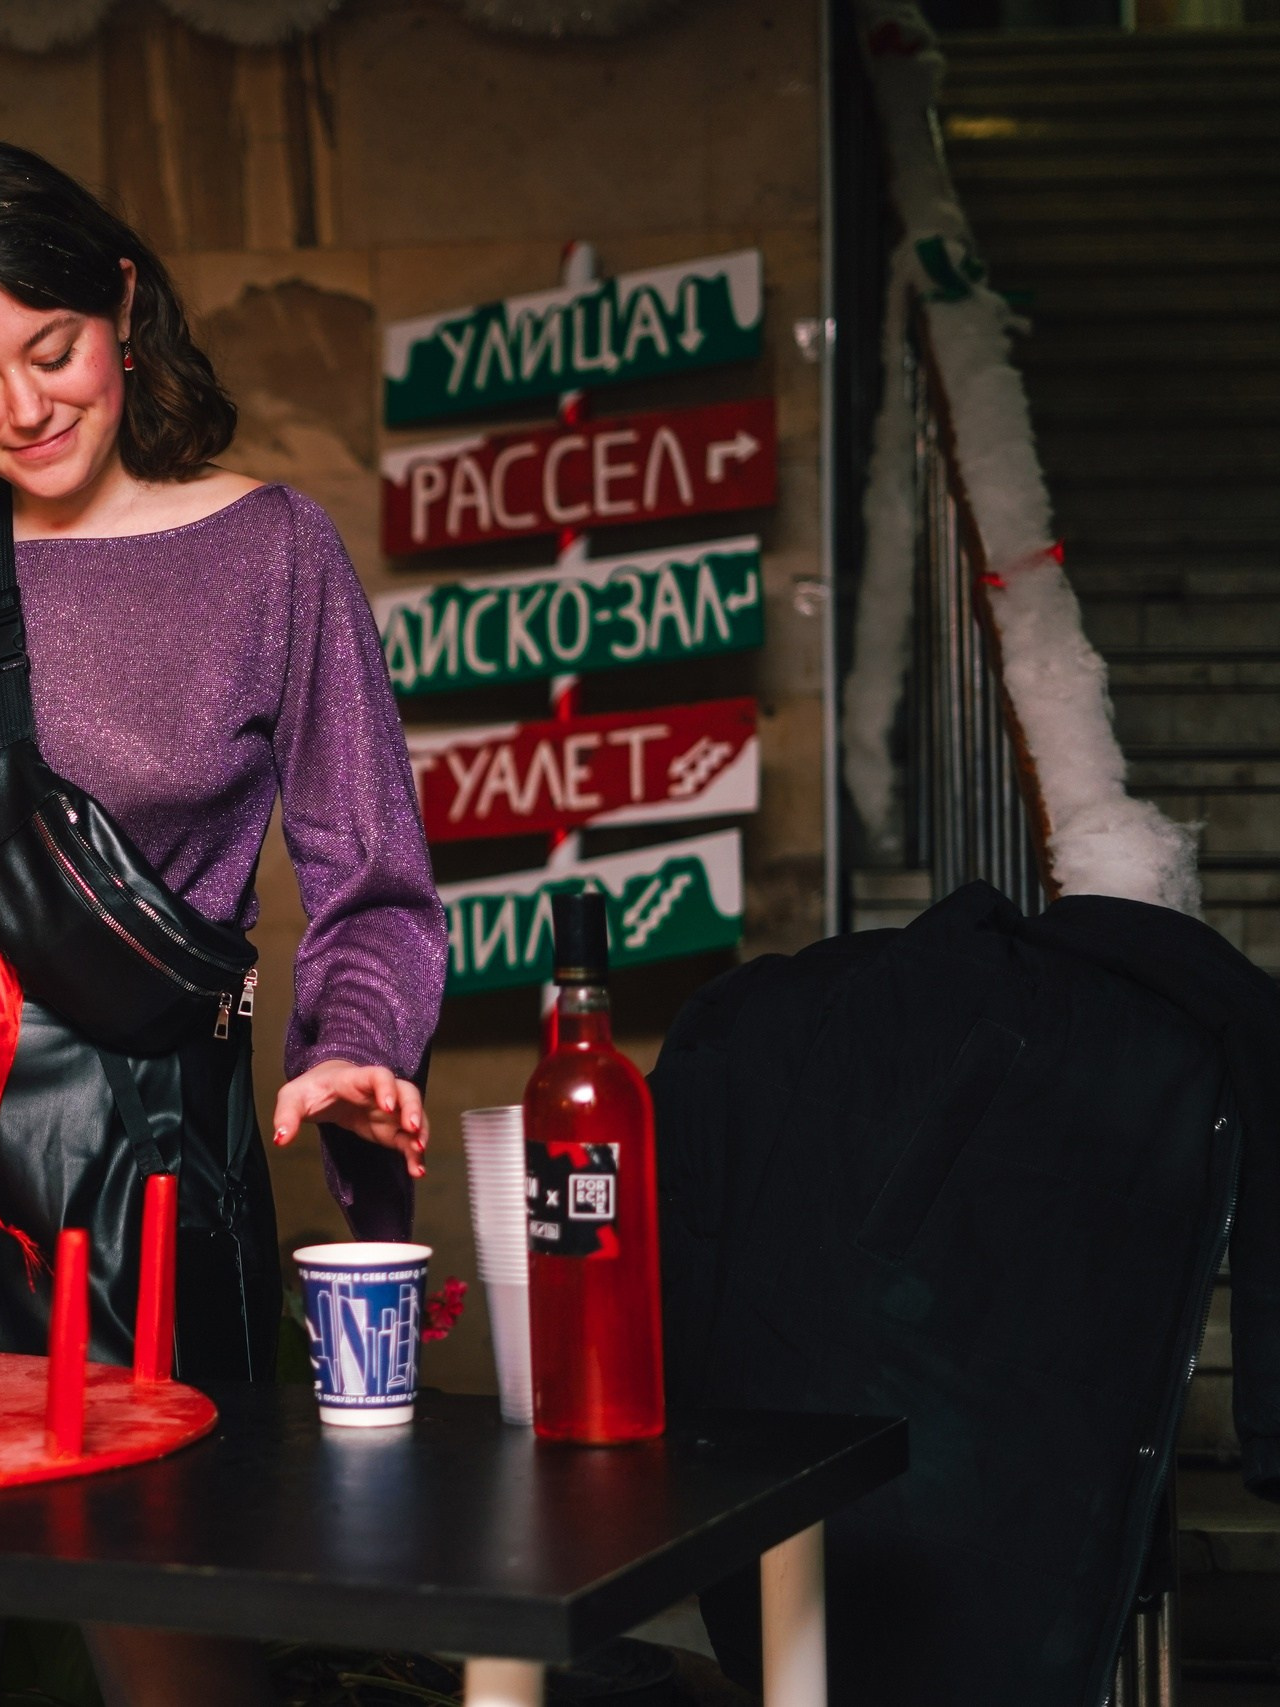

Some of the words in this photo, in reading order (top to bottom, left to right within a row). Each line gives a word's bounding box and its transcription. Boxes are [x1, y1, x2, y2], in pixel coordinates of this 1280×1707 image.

[441, 289, 669, 395] УЛИЦА
[411, 427, 694, 543] РАССЕЛ
[384, 563, 730, 688] ДИСКО-ЗАЛ
